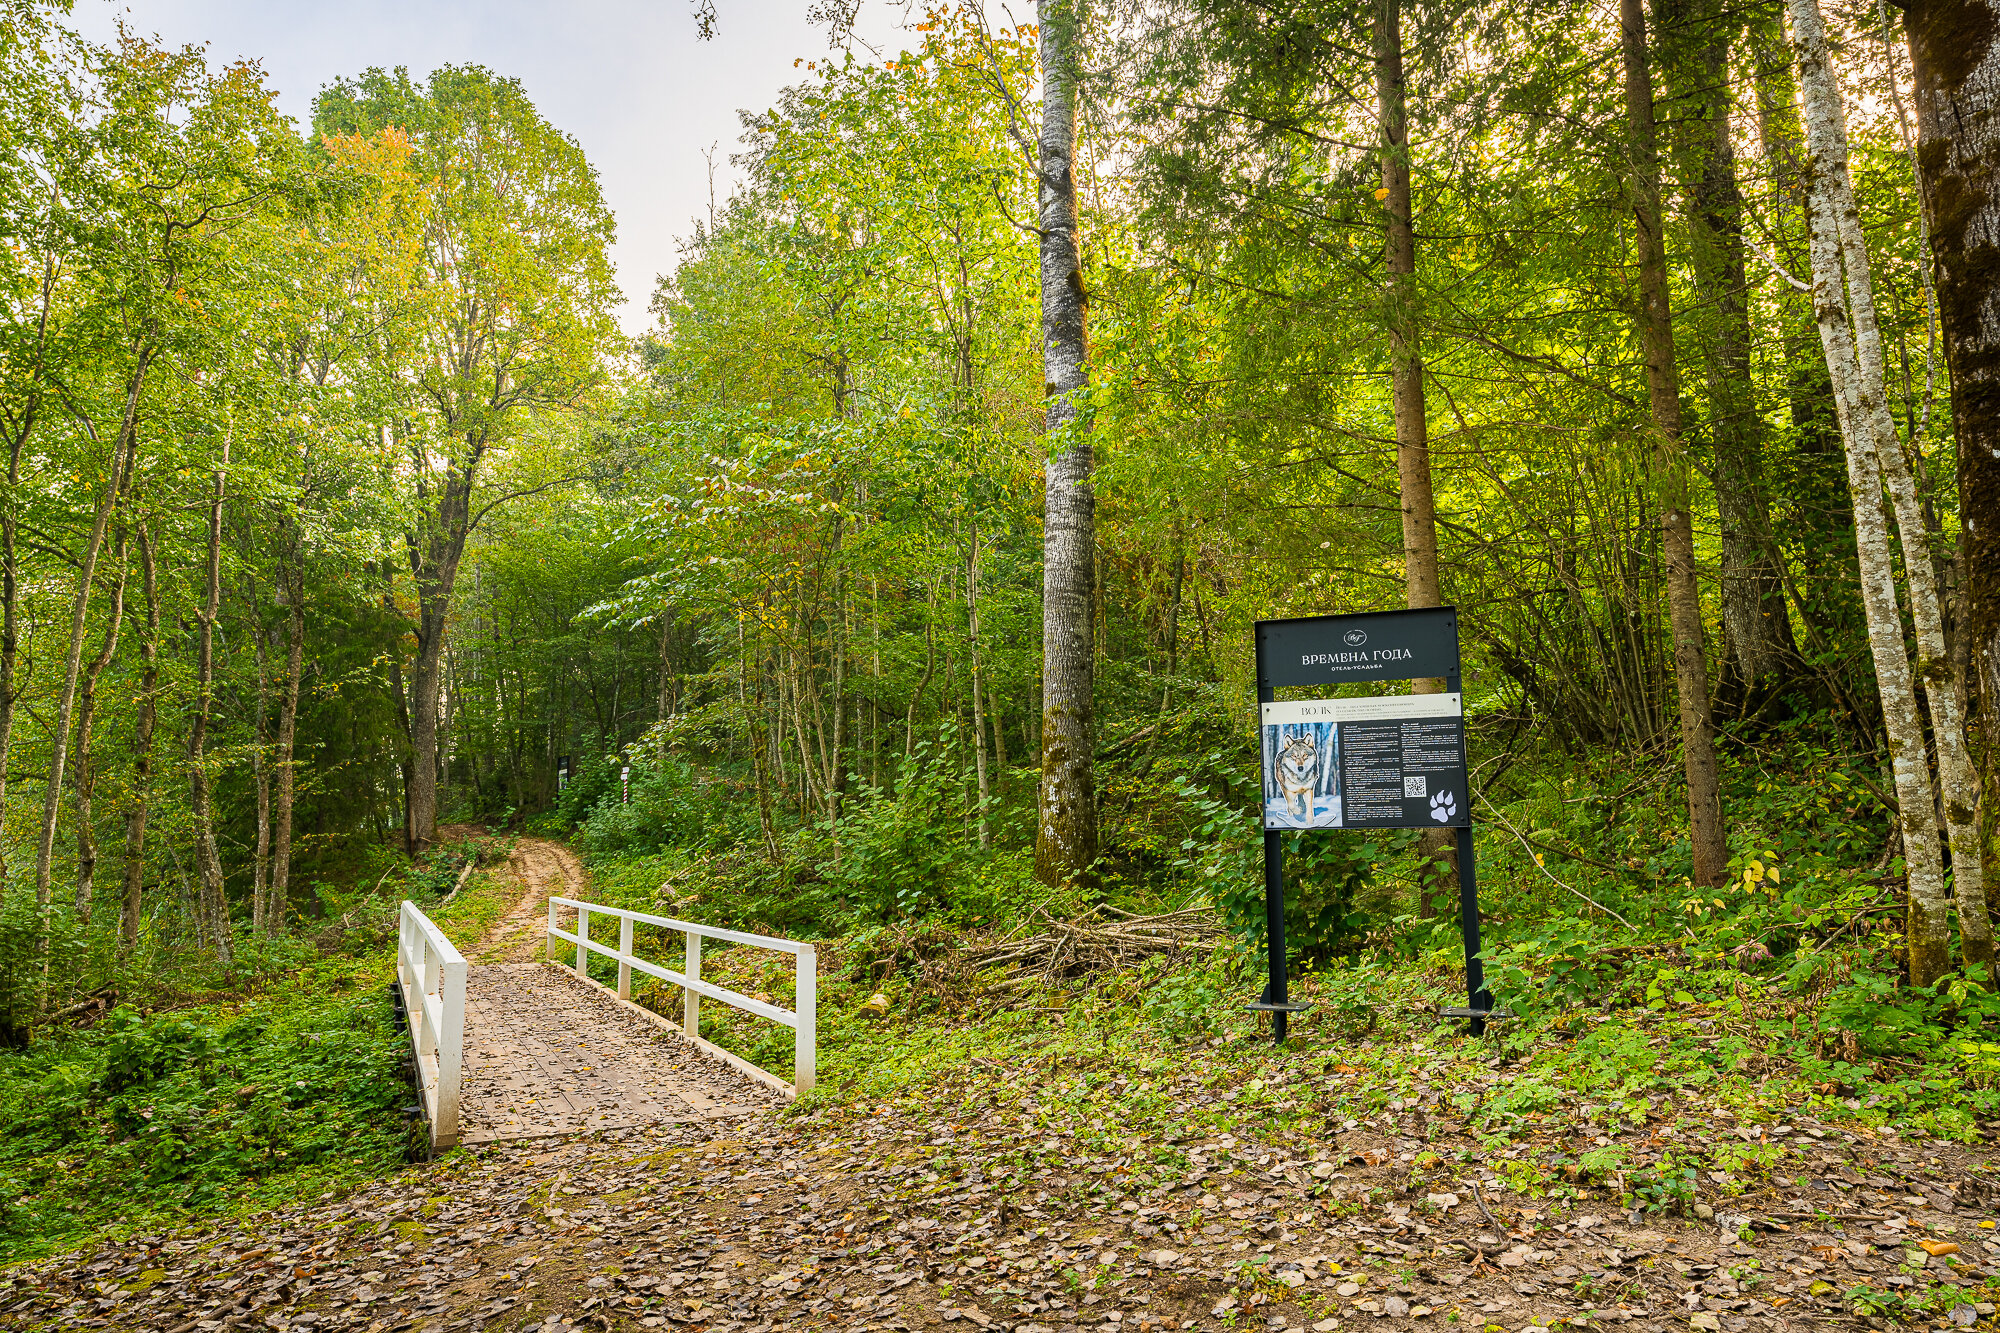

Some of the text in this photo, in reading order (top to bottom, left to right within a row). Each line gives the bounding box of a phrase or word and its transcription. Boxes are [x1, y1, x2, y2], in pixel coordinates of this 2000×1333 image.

[1302, 648, 1412, 665] ВРЕМЕНА ГОДА
[1301, 706, 1332, 716] ВОЛК
